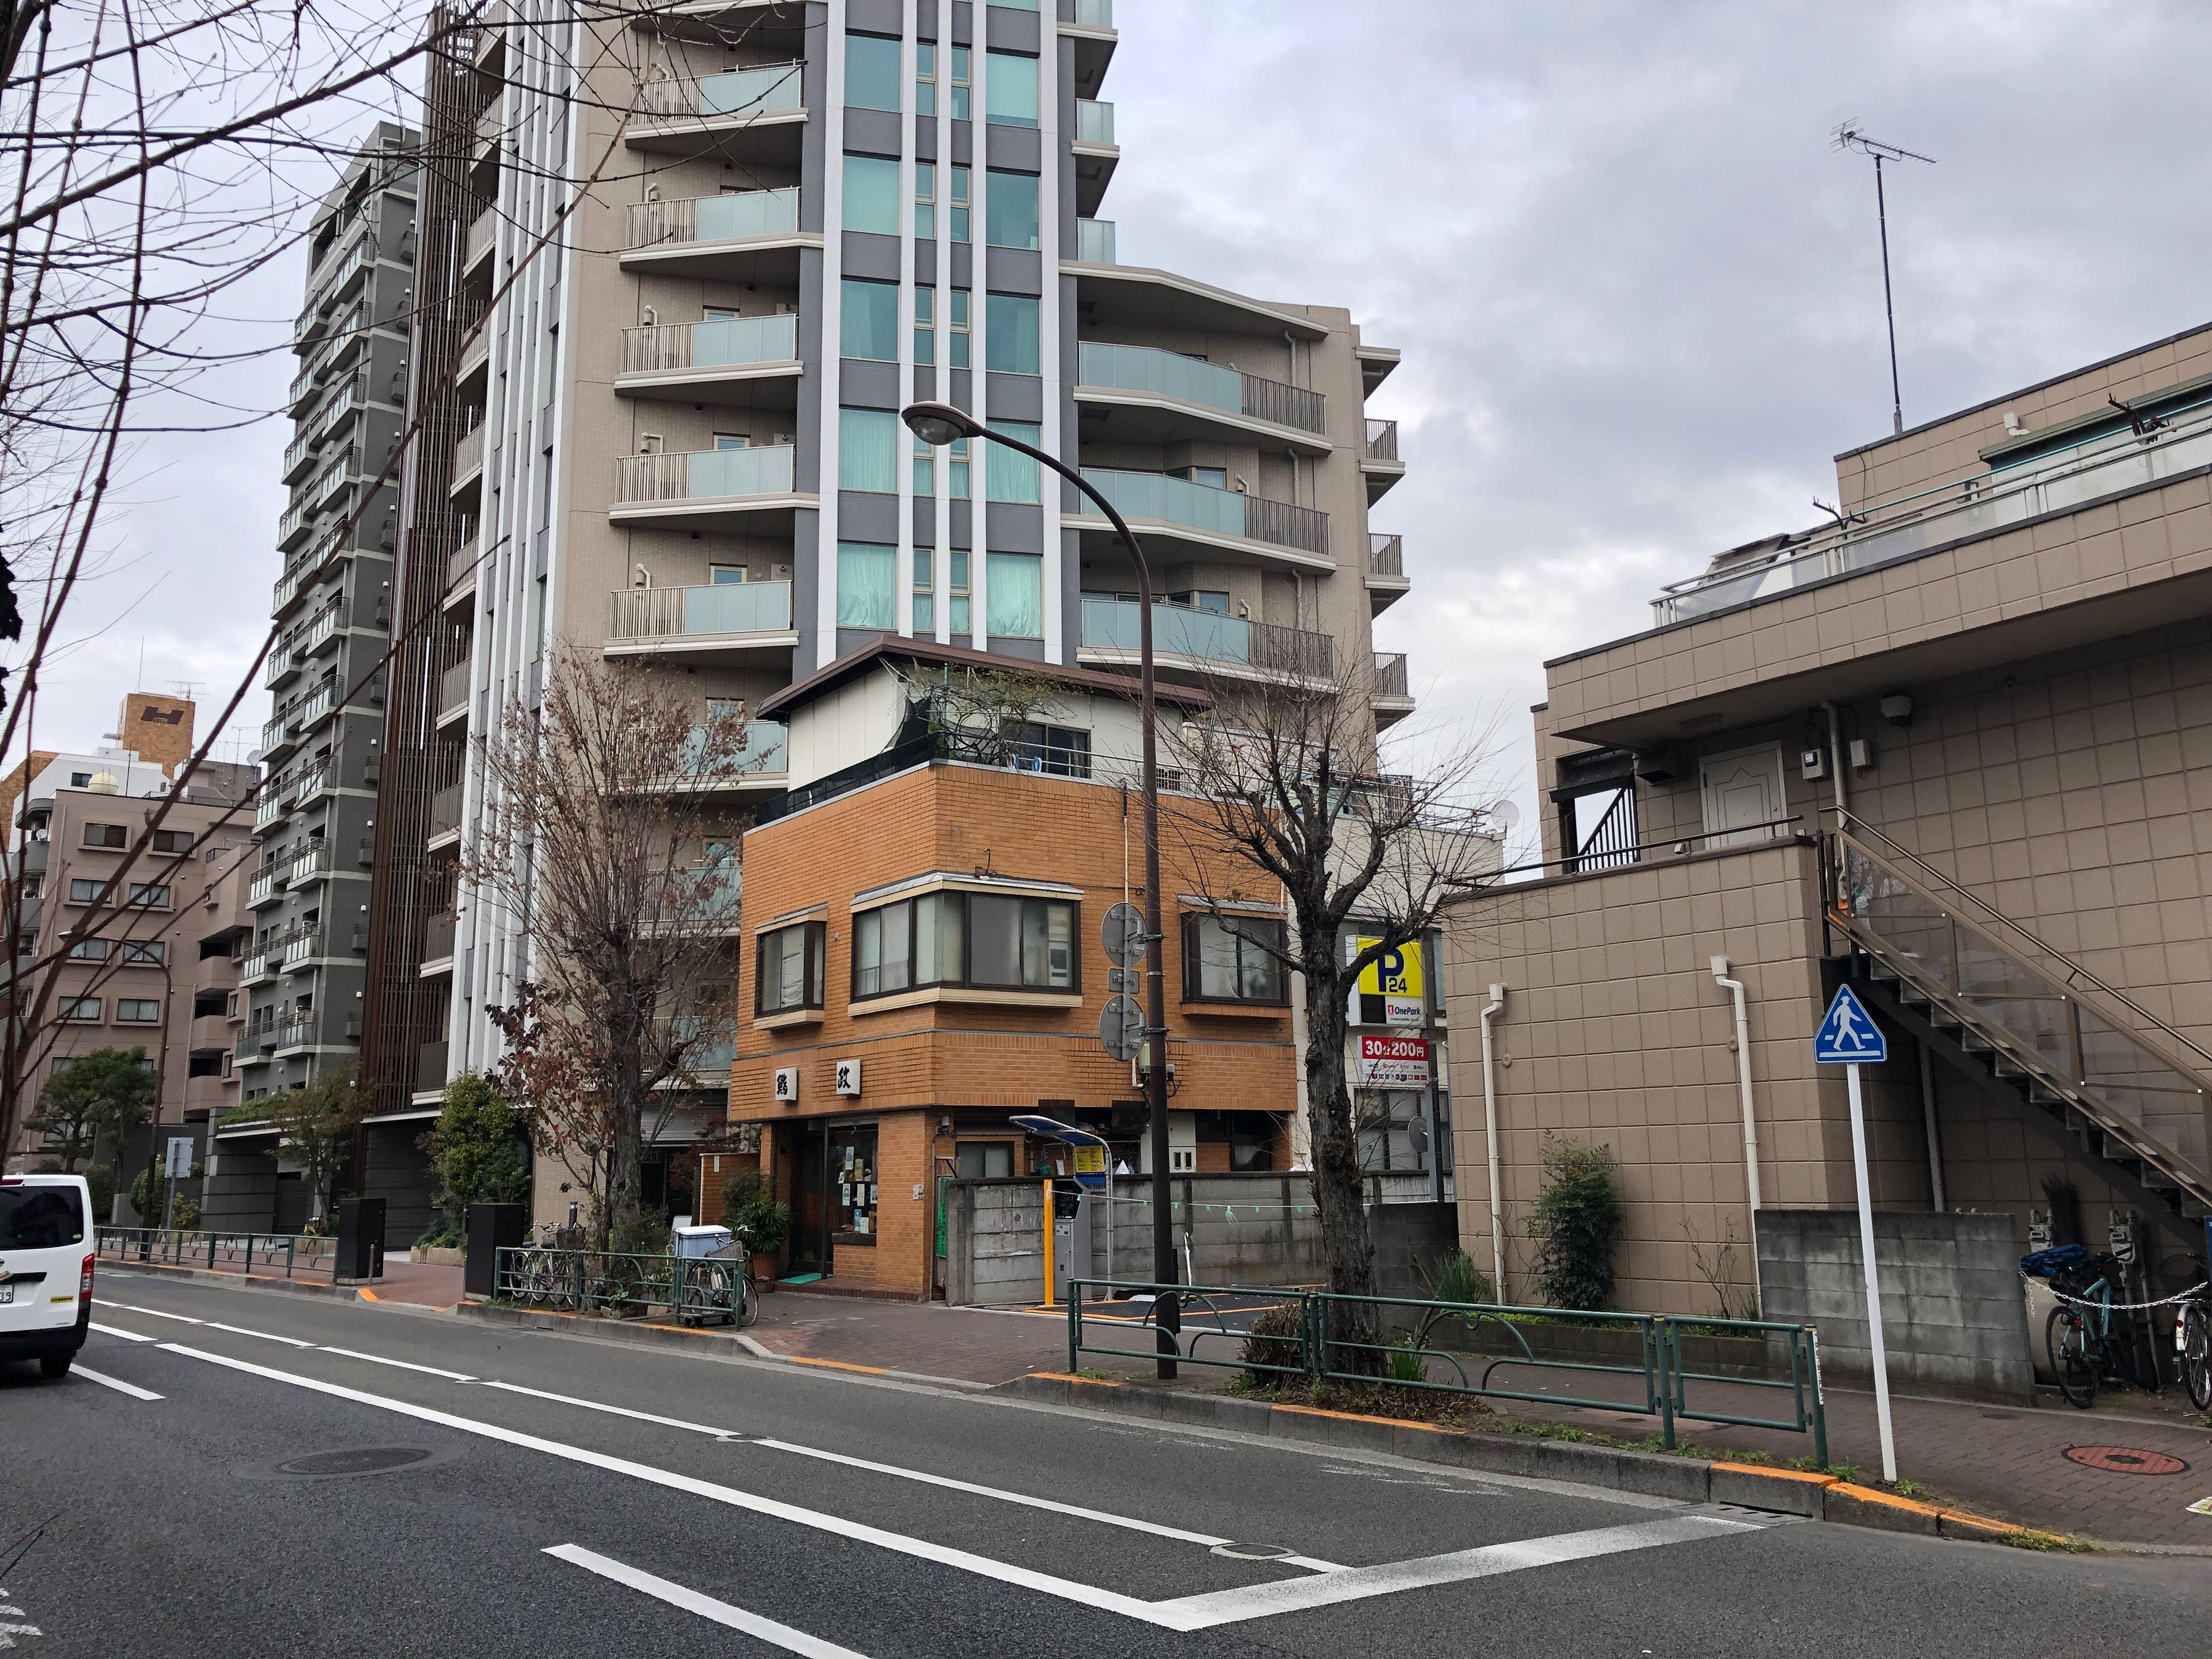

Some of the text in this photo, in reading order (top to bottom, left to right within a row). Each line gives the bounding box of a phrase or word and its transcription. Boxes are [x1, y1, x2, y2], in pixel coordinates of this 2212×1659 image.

[1377, 947, 1404, 992] P
[1389, 977, 1407, 993] 24
[1395, 1007, 1421, 1015] OnePark
